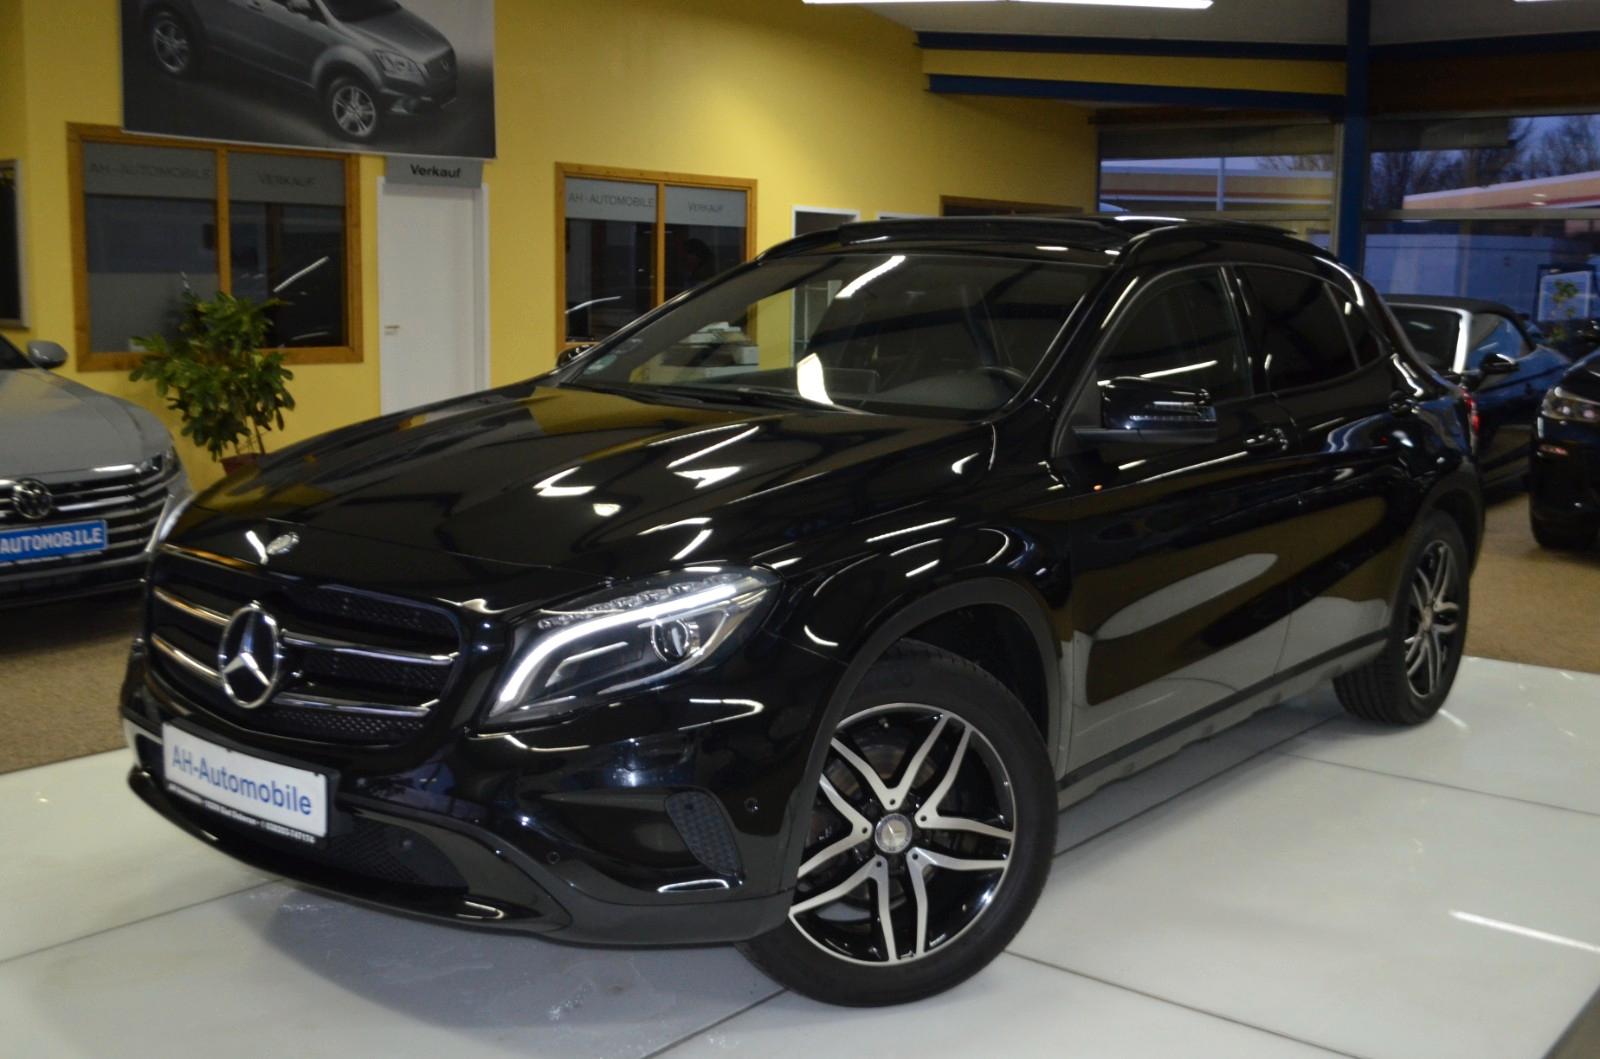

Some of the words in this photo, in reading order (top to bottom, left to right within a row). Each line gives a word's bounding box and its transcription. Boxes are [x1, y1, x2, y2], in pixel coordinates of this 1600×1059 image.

[409, 163, 462, 178] Verkauf
[0, 527, 103, 554] AUTOMOBILE
[172, 745, 312, 816] AH-Automobile
